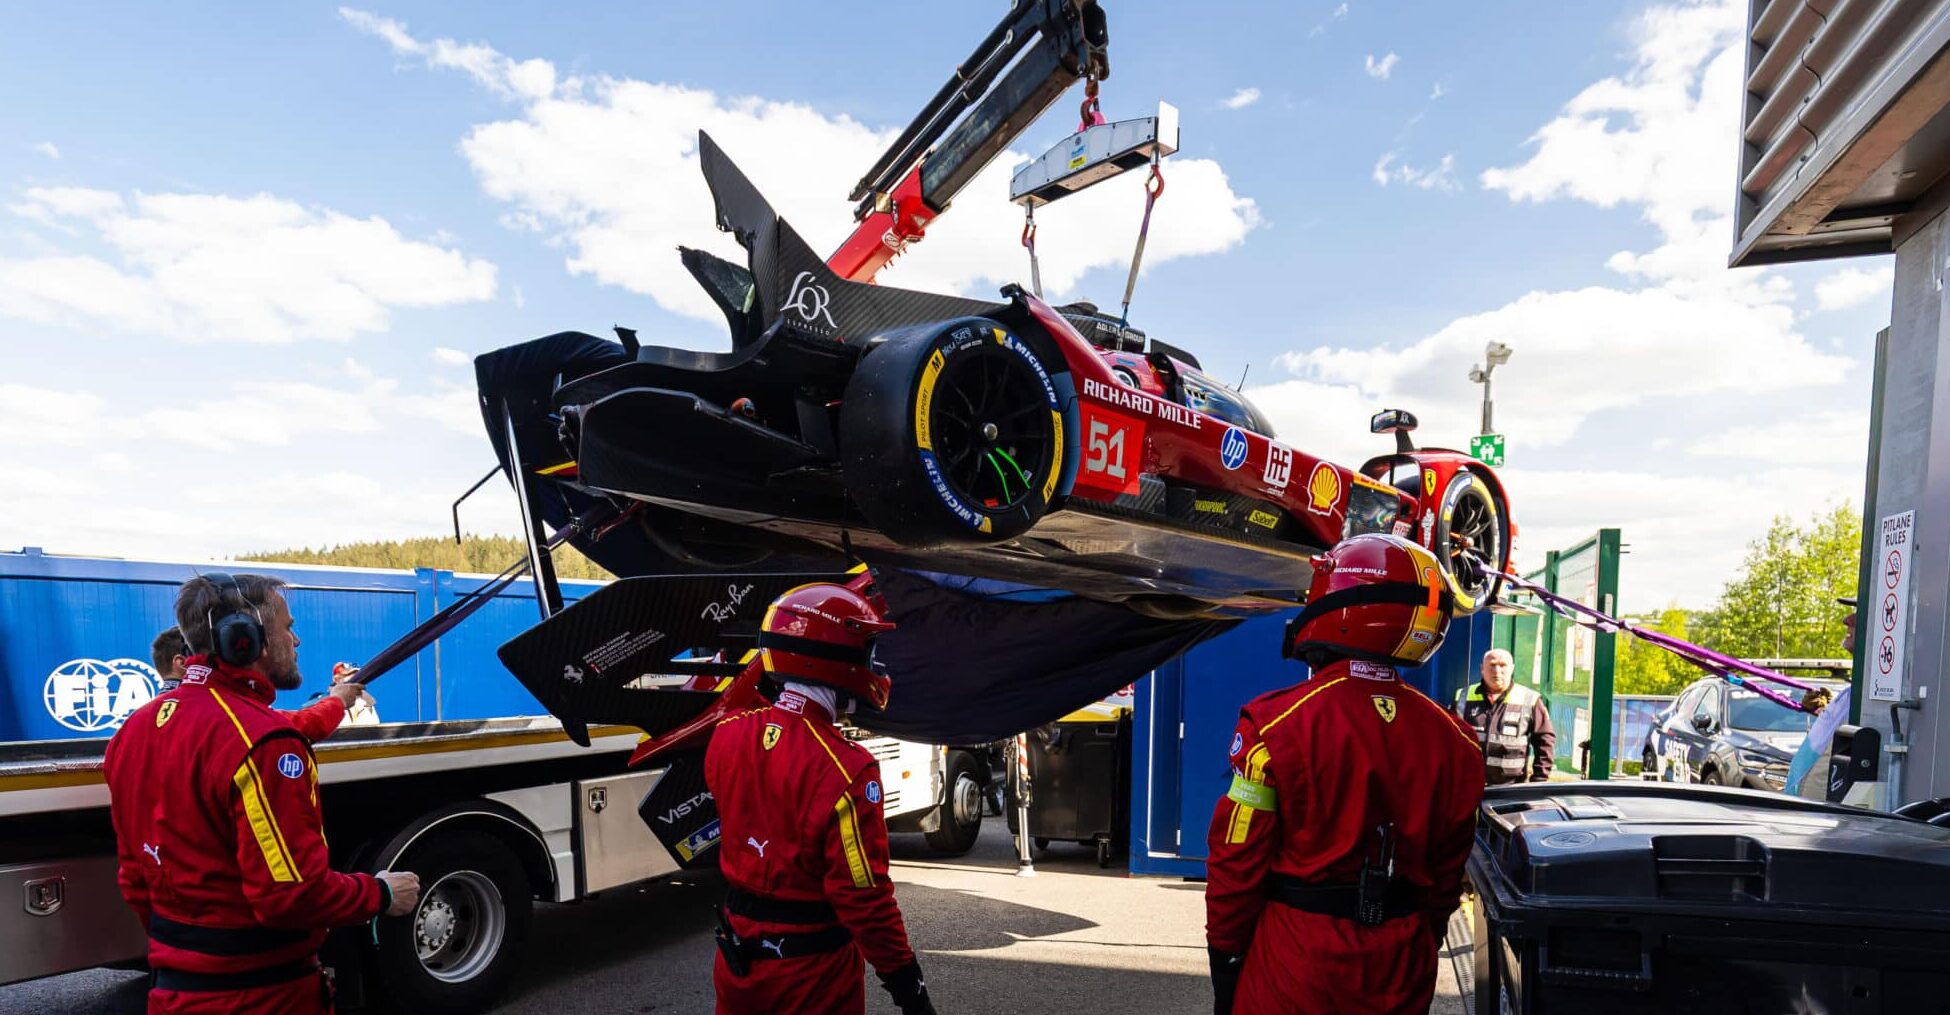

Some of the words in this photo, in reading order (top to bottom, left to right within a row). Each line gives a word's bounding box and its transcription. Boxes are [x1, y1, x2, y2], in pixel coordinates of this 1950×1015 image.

[932, 355, 943, 372] M
[1014, 342, 1058, 404] MICHELIN
[1083, 378, 1153, 415] RICHARD
[1158, 402, 1202, 430] MILLE
[1086, 420, 1127, 479] 51
[1223, 428, 1246, 469] hp
[925, 457, 972, 522] MICHELIN
[1883, 514, 1911, 533] PITLANE
[1885, 530, 1907, 547] RULES
[1363, 568, 1388, 576] MILLE
[791, 603, 821, 615] RICHARD
[821, 611, 841, 624] MILLE
[1413, 631, 1429, 641] BELL
[283, 753, 300, 777] hp
